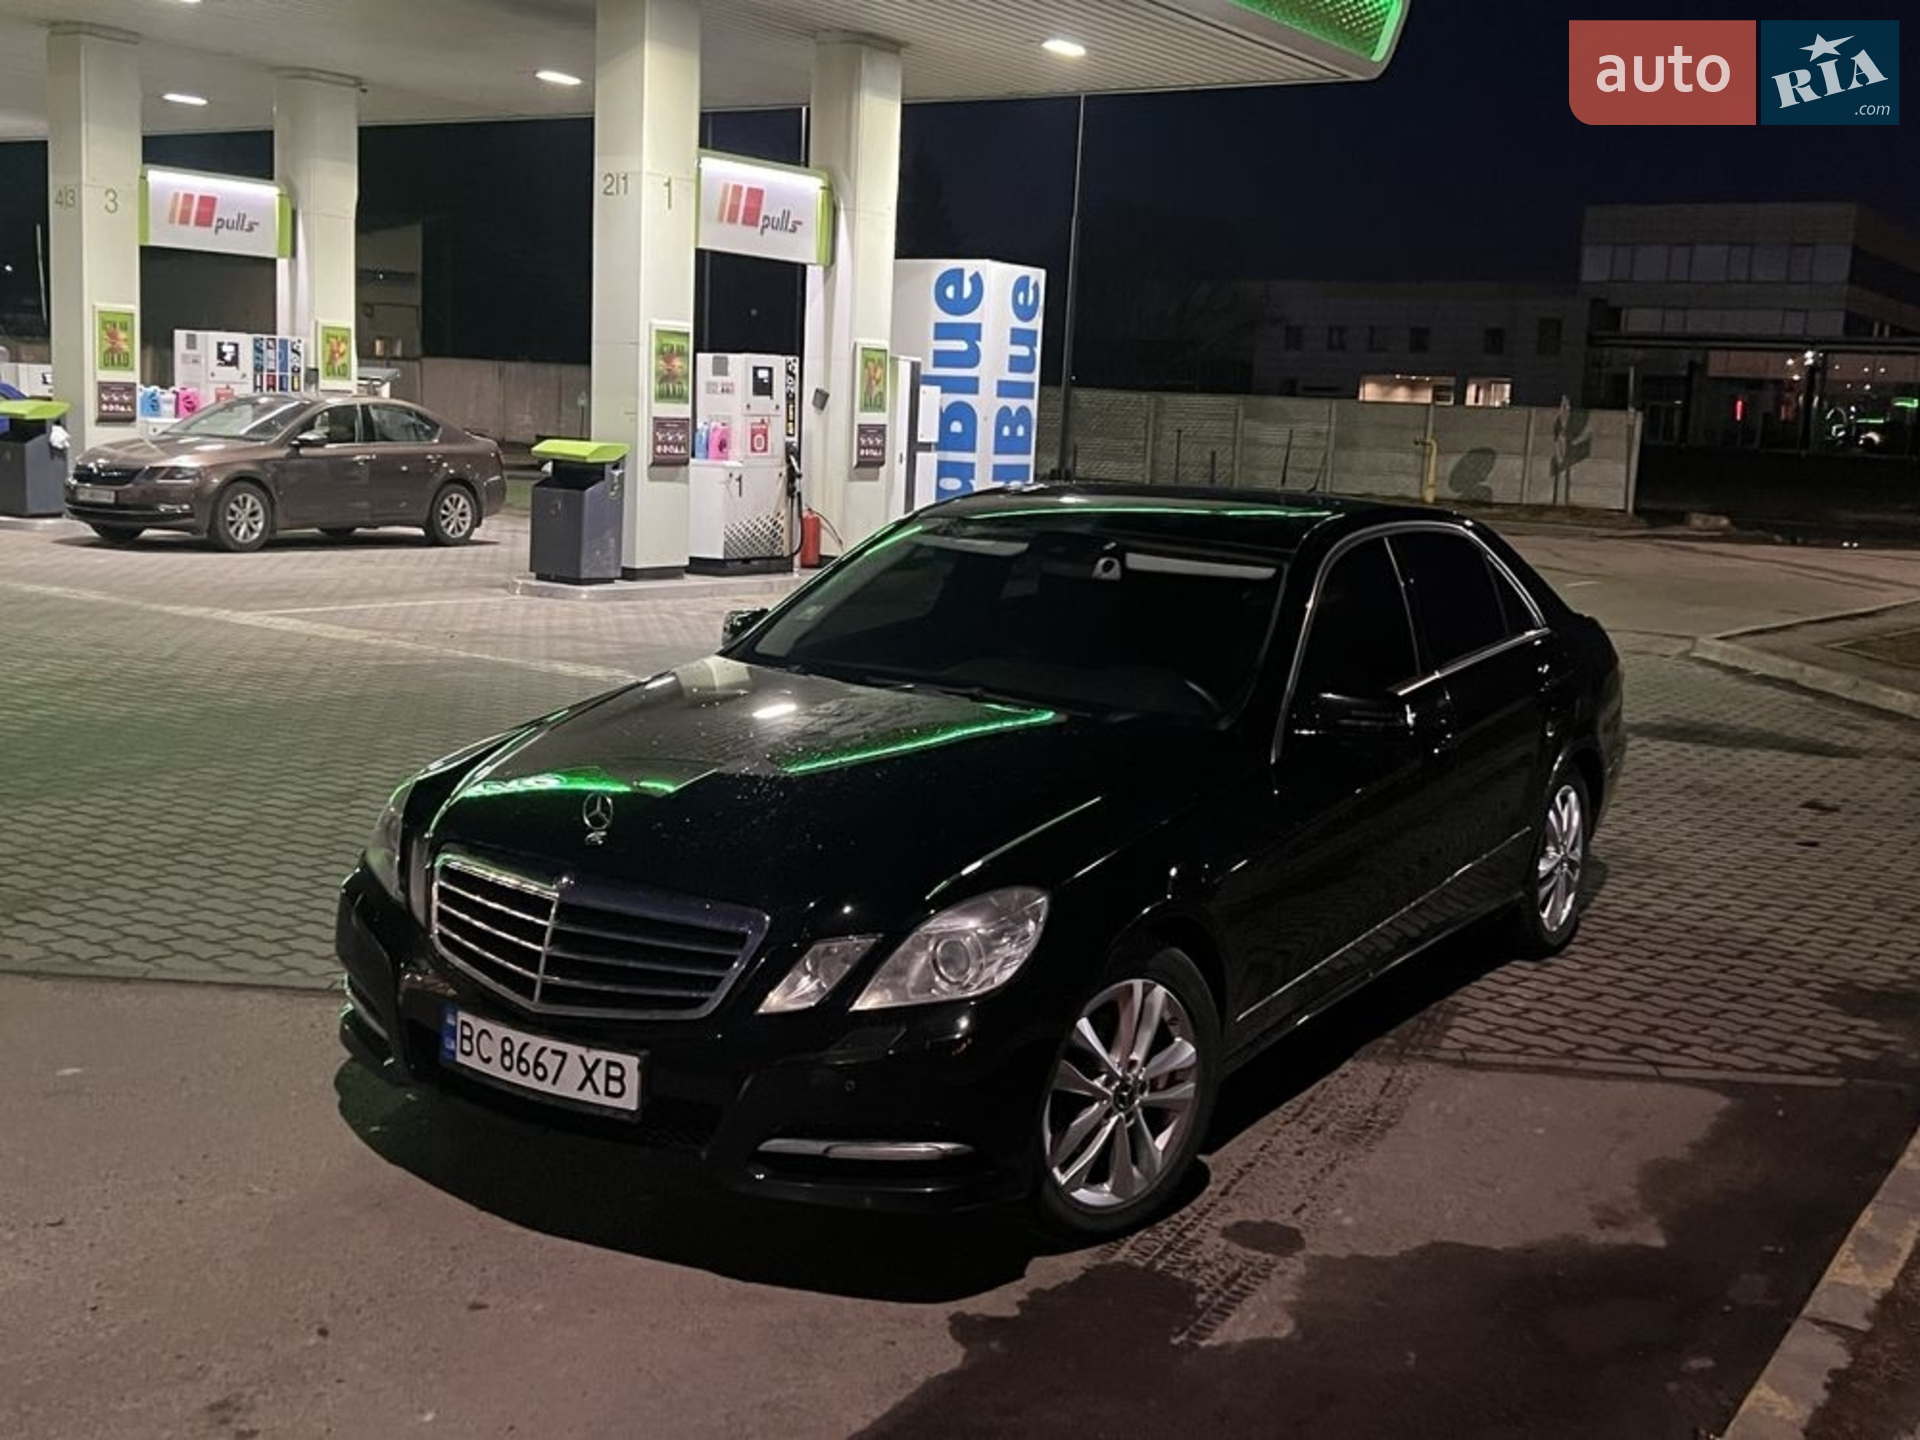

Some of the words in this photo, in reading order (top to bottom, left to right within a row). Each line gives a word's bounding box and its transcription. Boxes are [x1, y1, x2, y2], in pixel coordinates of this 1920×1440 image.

[104, 188, 119, 214] 3
[663, 177, 672, 210] 1
[214, 212, 260, 235] pulls
[760, 209, 804, 236] pulls
[735, 474, 743, 498] 1
[459, 1019, 494, 1065] BC
[500, 1036, 568, 1086] 8667
[577, 1054, 627, 1099] XB
